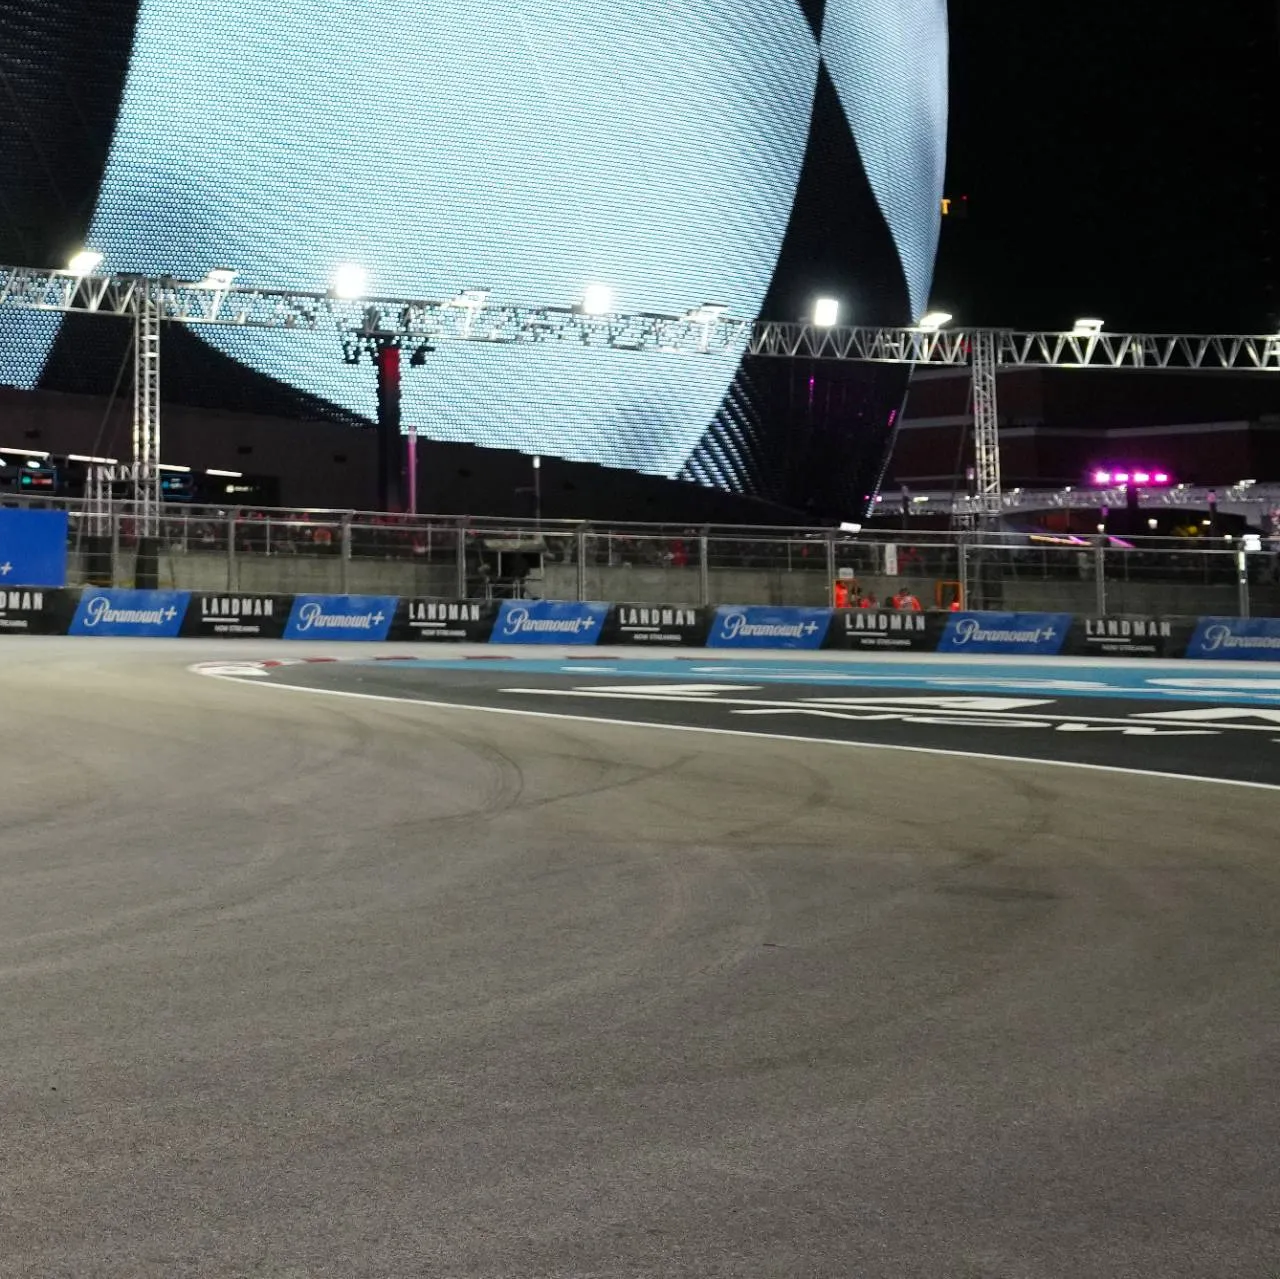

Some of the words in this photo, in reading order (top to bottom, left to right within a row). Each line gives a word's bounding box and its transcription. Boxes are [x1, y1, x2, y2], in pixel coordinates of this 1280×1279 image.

[84, 596, 177, 627] Paramount+
[202, 597, 273, 616] LANDMAN
[296, 603, 384, 631] Paramount+
[409, 603, 480, 620] LANDMAN
[620, 608, 695, 625] LANDMAN
[503, 607, 595, 635] Paramount+
[721, 613, 819, 640] Paramount+
[845, 613, 925, 631] LANDMAN
[952, 618, 1056, 645] Paramount+
[1085, 619, 1171, 637] LANDMAN
